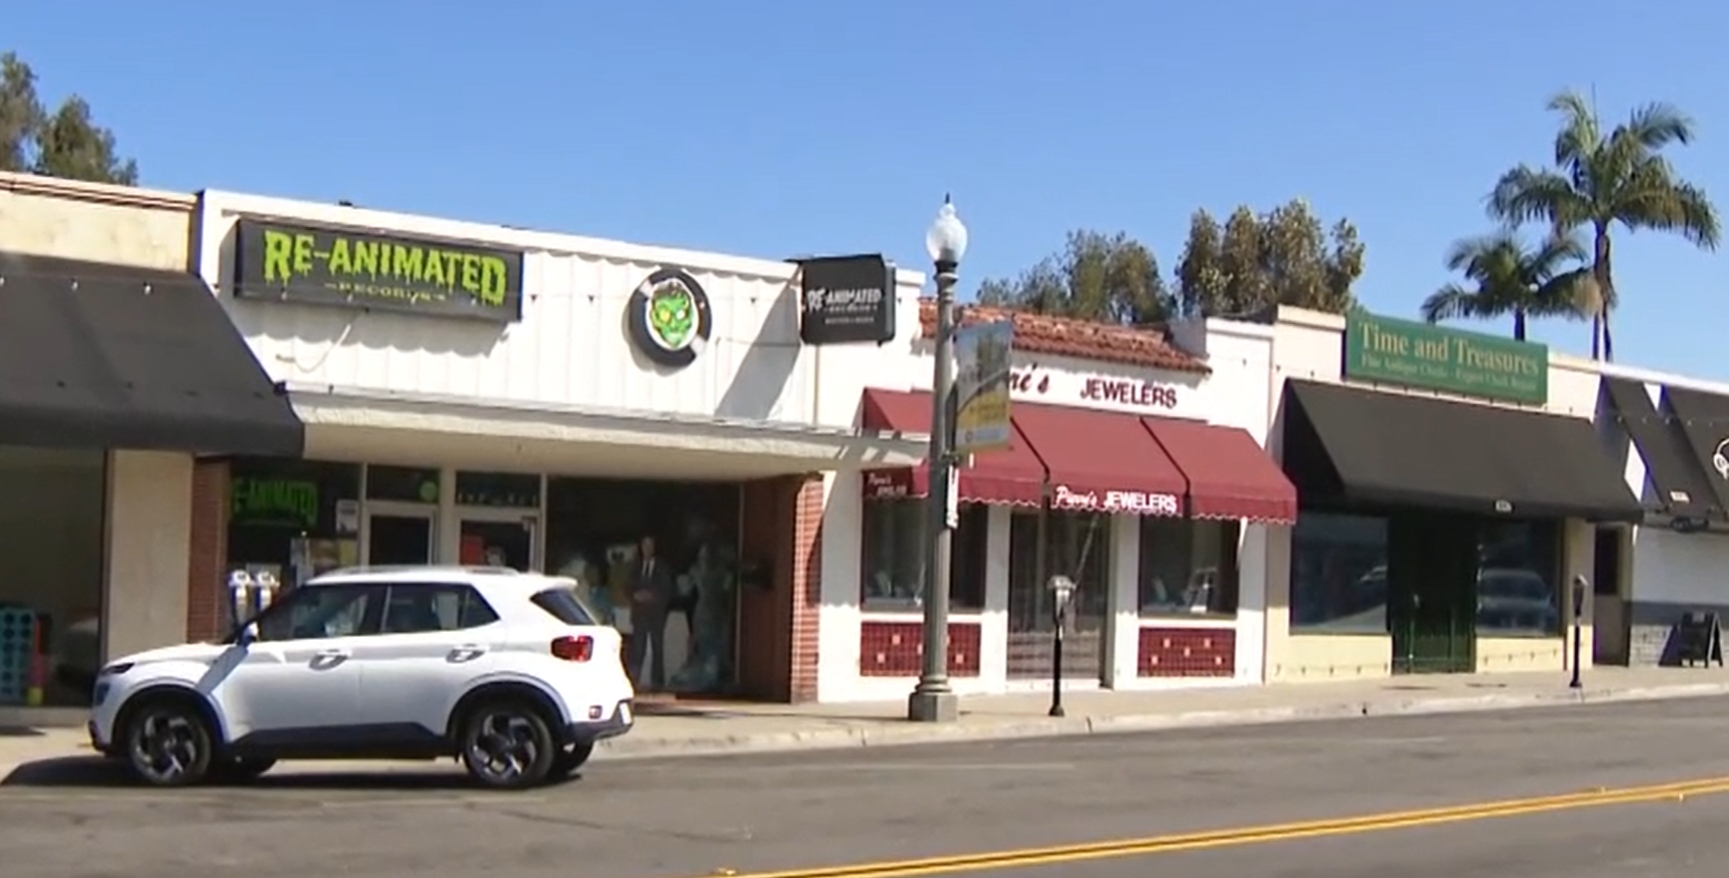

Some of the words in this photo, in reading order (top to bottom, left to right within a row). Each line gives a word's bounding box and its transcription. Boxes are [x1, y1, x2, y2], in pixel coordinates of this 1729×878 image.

[264, 229, 507, 307] RE-ANIMATED
[1358, 320, 1409, 356] Time
[1414, 335, 1449, 362] and
[1453, 338, 1539, 375] Treasures
[1079, 377, 1178, 410] JEWELERS
[1103, 490, 1178, 514] JEWELERS
